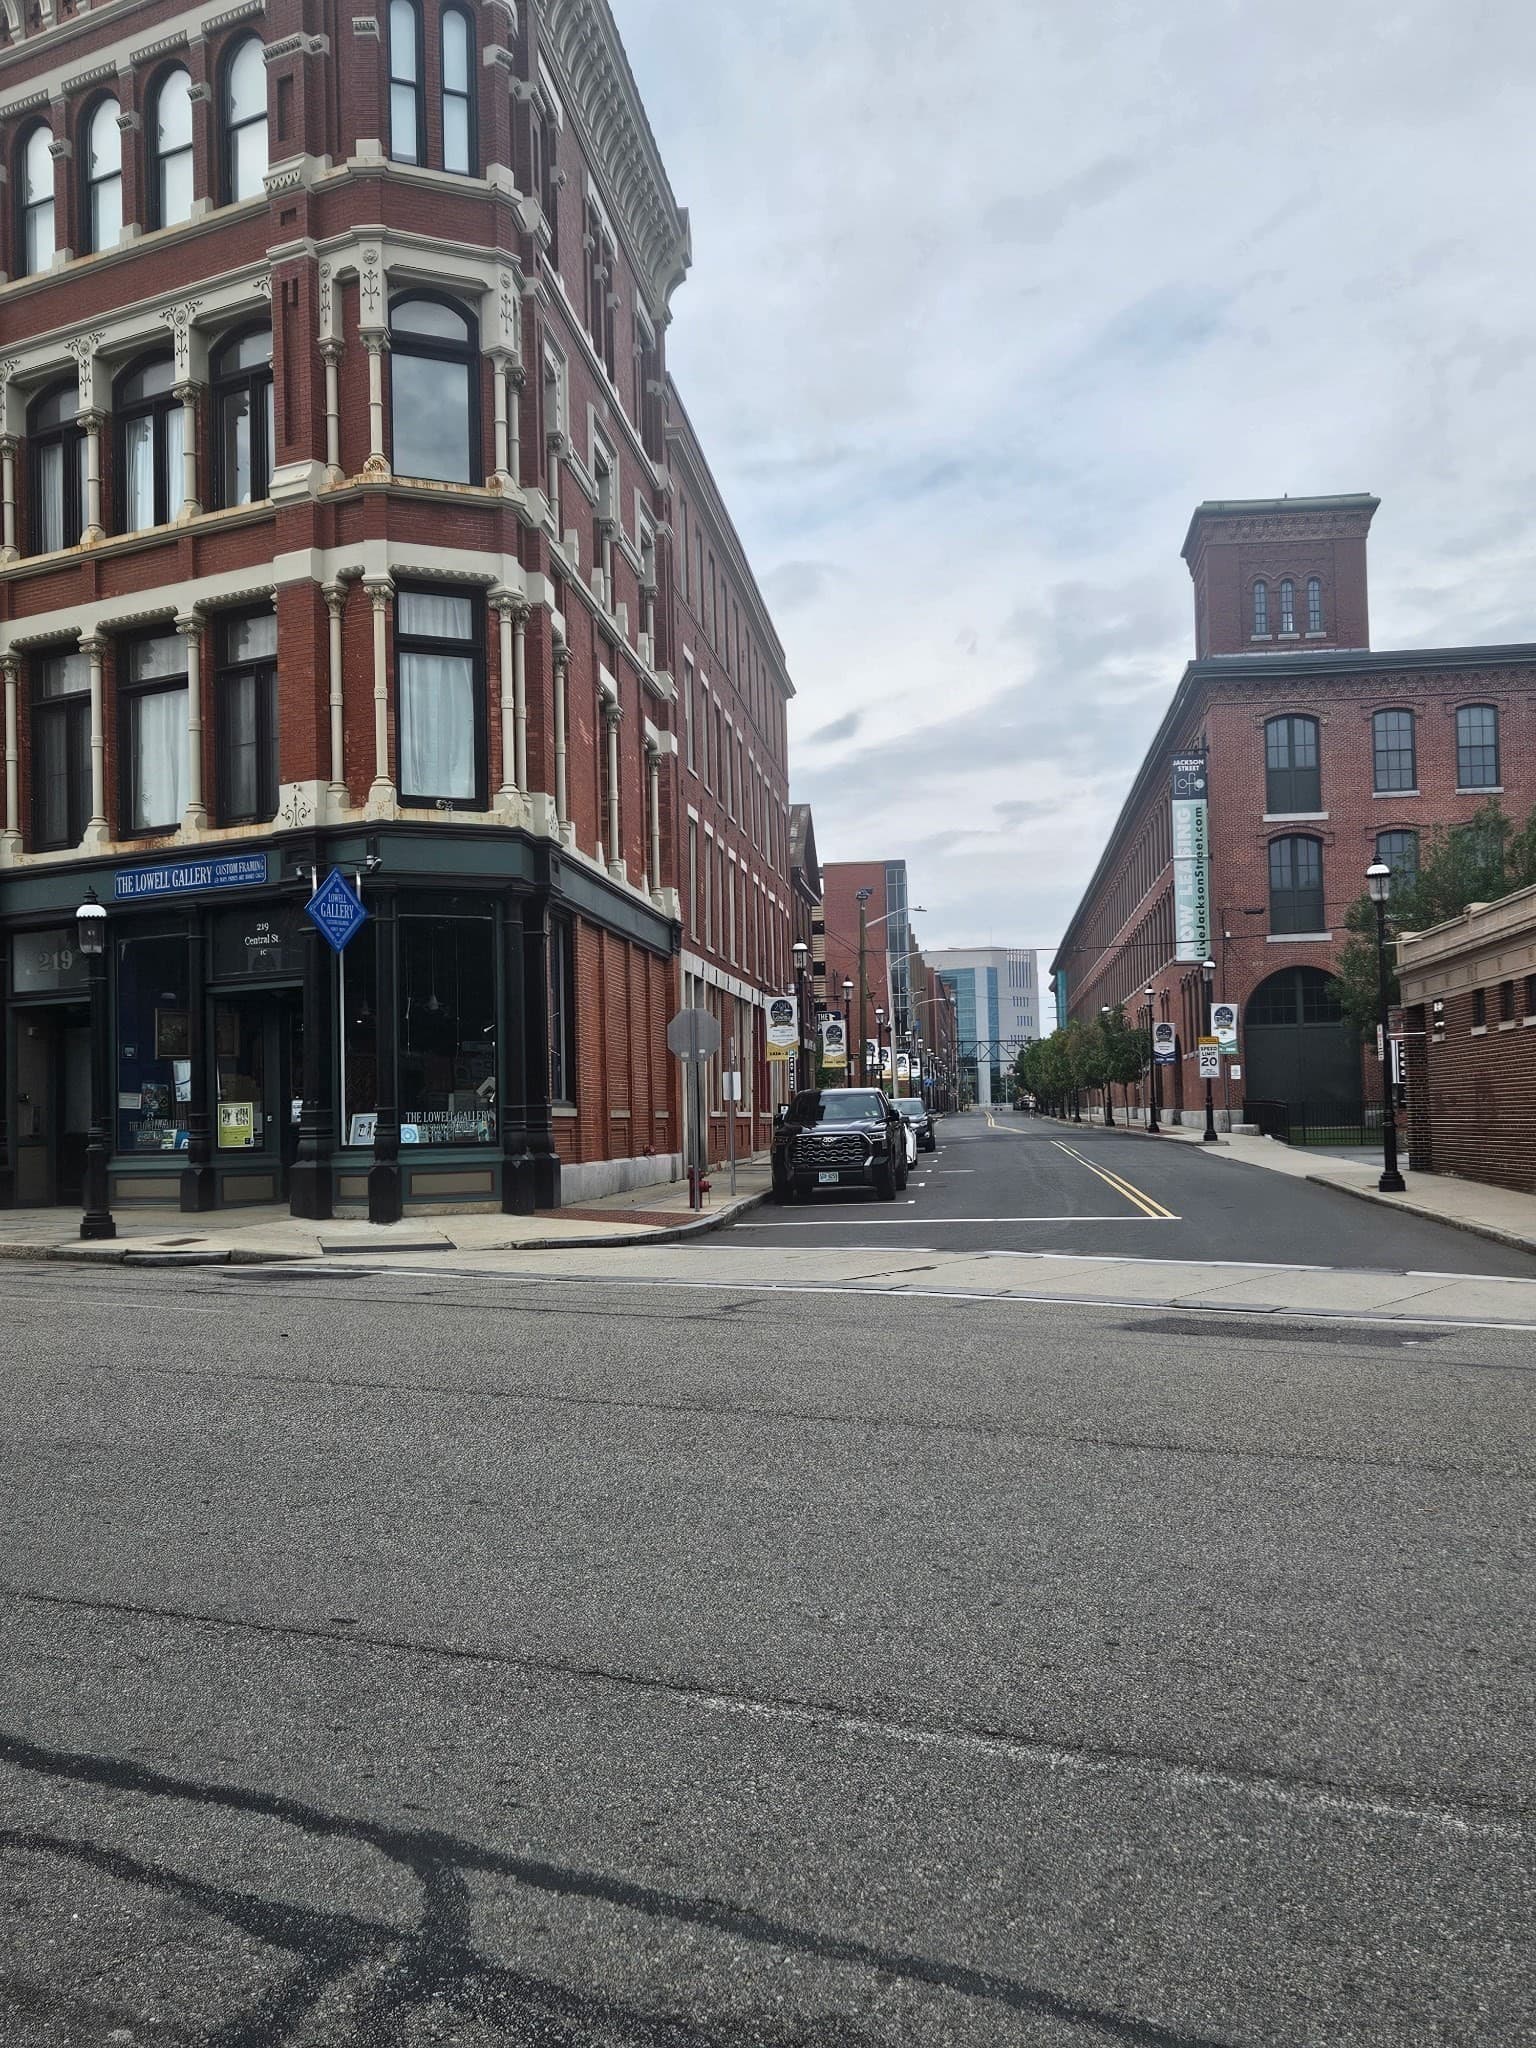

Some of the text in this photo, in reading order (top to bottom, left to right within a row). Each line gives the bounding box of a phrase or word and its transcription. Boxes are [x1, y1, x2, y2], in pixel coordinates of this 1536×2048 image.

[215, 862, 239, 876] CUSTOM
[116, 875, 134, 894] THE
[135, 871, 171, 892] LOWELL
[171, 866, 213, 888] GALLERY
[1176, 806, 1195, 959] NOW LEASING
[1194, 806, 1207, 958] LiveJacksonStreet.com
[328, 893, 347, 904] LOWELL
[320, 902, 354, 919] GALLERY
[256, 922, 269, 932] 219
[244, 933, 270, 946] Central
[39, 949, 73, 971] 219
[817, 1013, 829, 1021] THE
[1201, 1057, 1218, 1067] 20
[405, 1111, 422, 1123] THE
[423, 1111, 453, 1122] LOWELL
